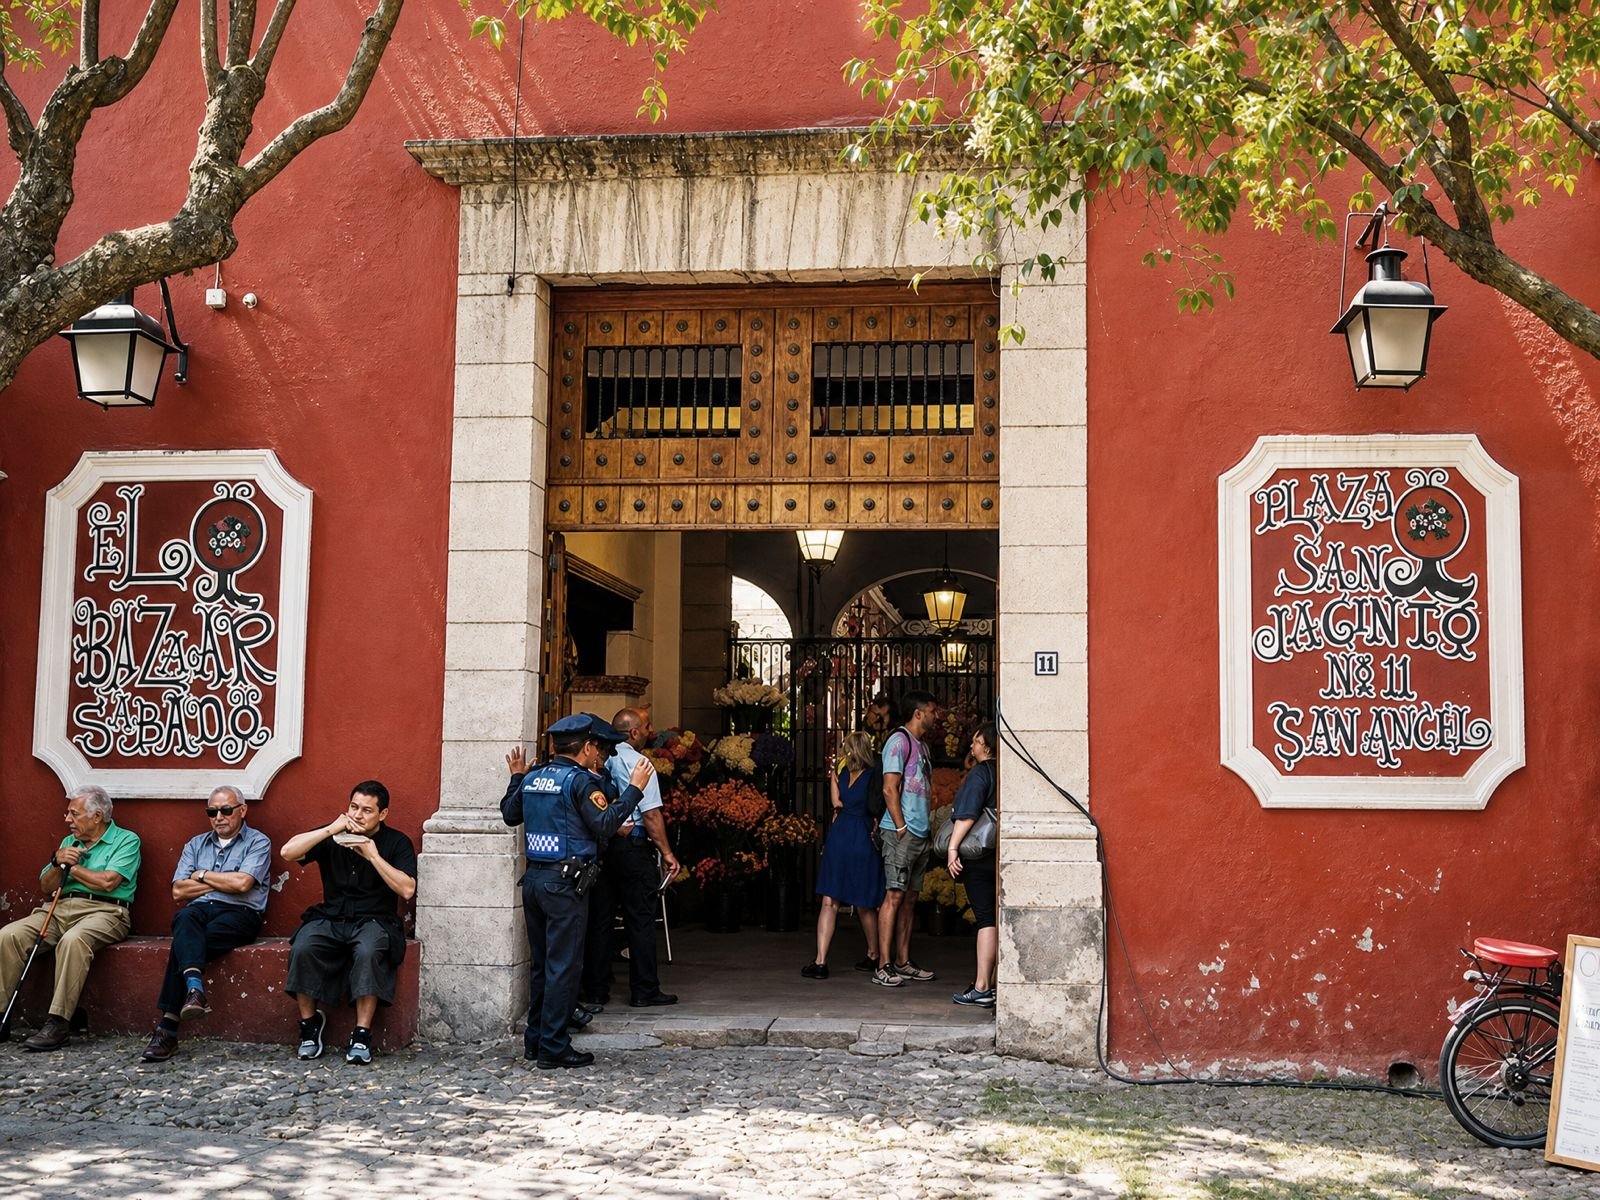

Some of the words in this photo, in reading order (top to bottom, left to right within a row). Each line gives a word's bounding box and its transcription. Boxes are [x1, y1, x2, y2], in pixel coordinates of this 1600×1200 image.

[1255, 471, 1394, 533] PLAZA
[84, 484, 195, 592] EL
[1275, 535, 1391, 595] SAN
[1253, 592, 1480, 662] JACINTO
[1039, 655, 1055, 672] 11
[1381, 654, 1417, 700] 11
[1267, 703, 1360, 770] SAN
